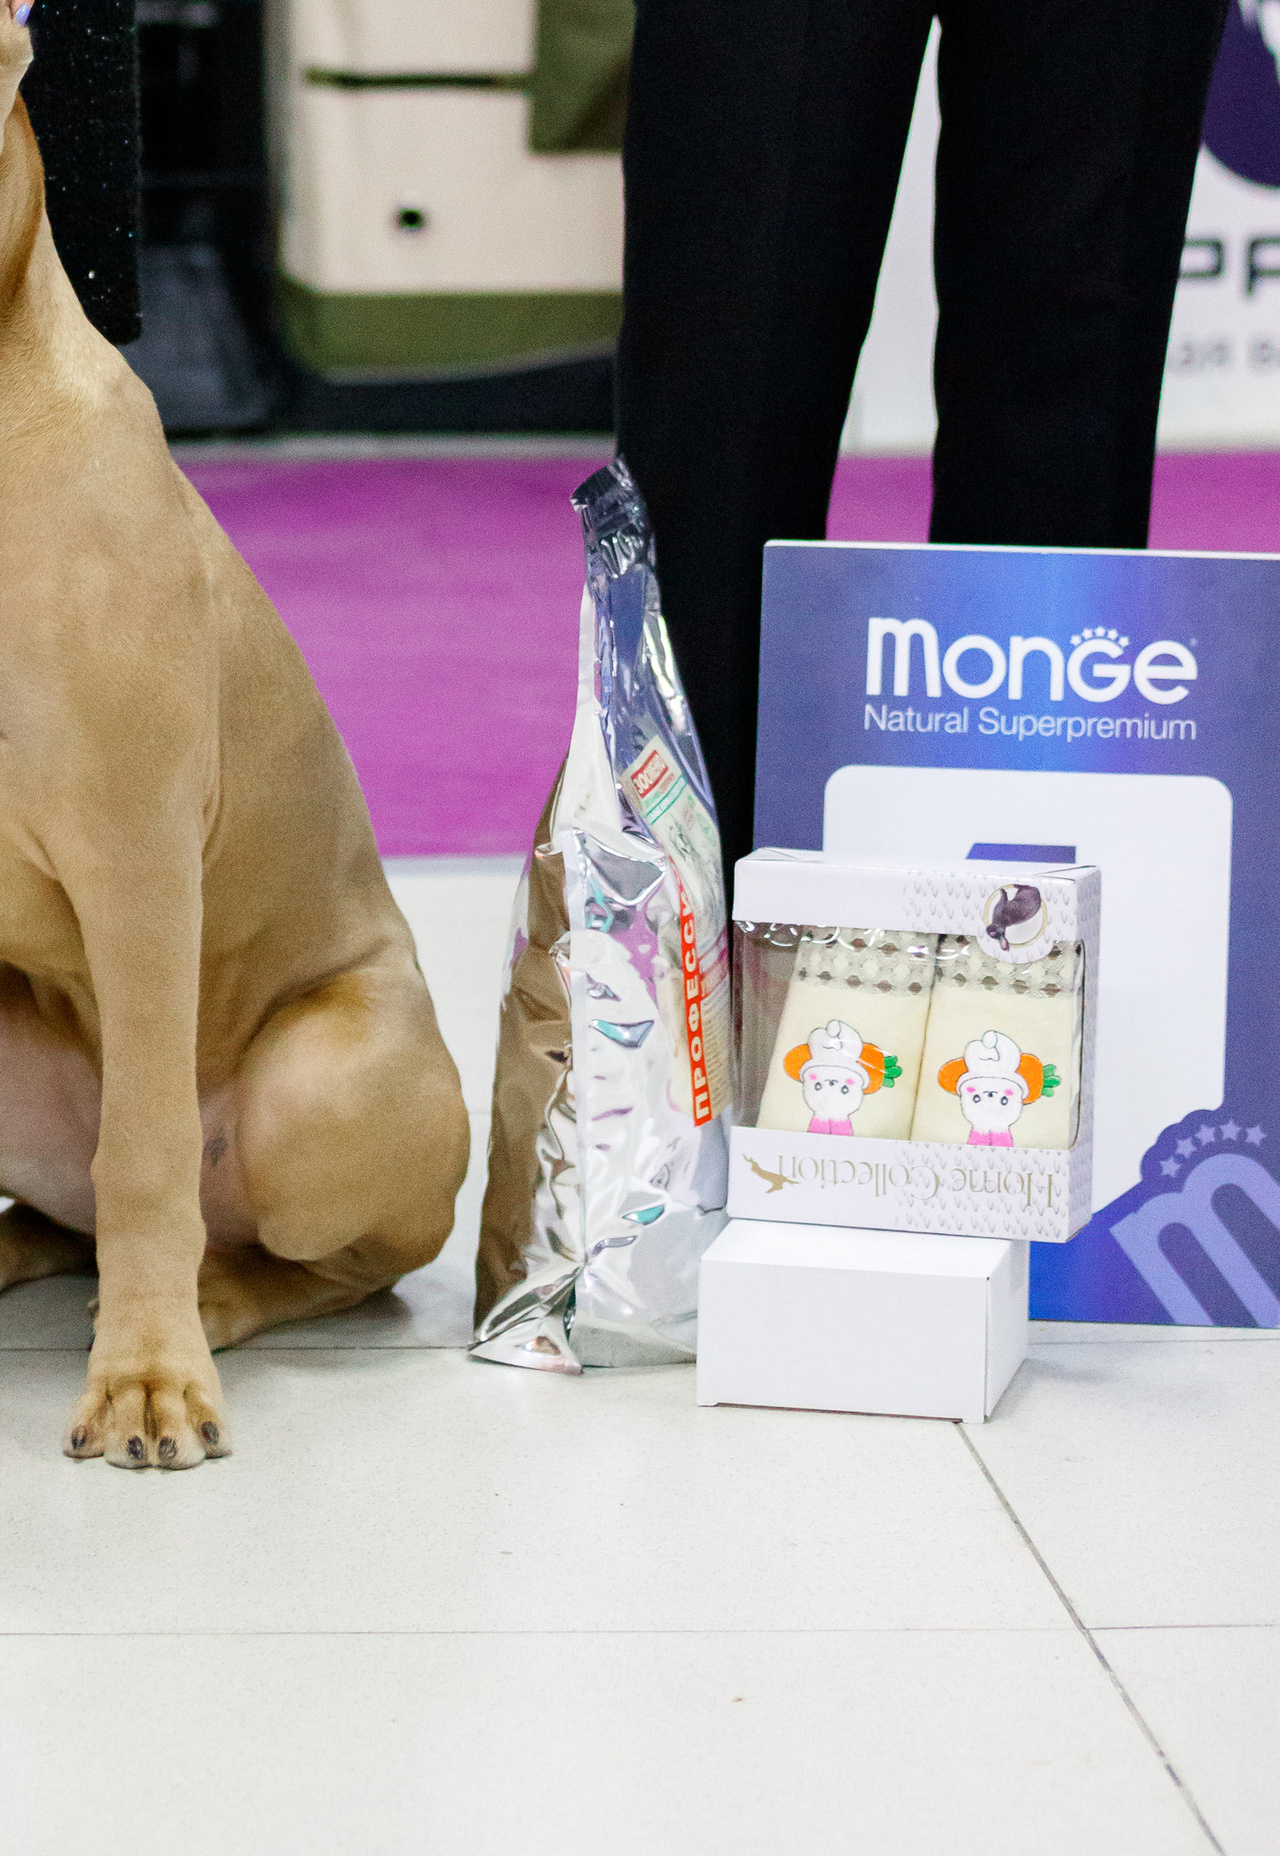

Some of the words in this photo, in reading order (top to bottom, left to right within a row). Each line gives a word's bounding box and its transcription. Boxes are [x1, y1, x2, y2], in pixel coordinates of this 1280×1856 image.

[864, 703, 969, 733] Natural
[978, 706, 1197, 743] Superpremium
[778, 1154, 940, 1200] Collection
[951, 1167, 1054, 1208] Home
